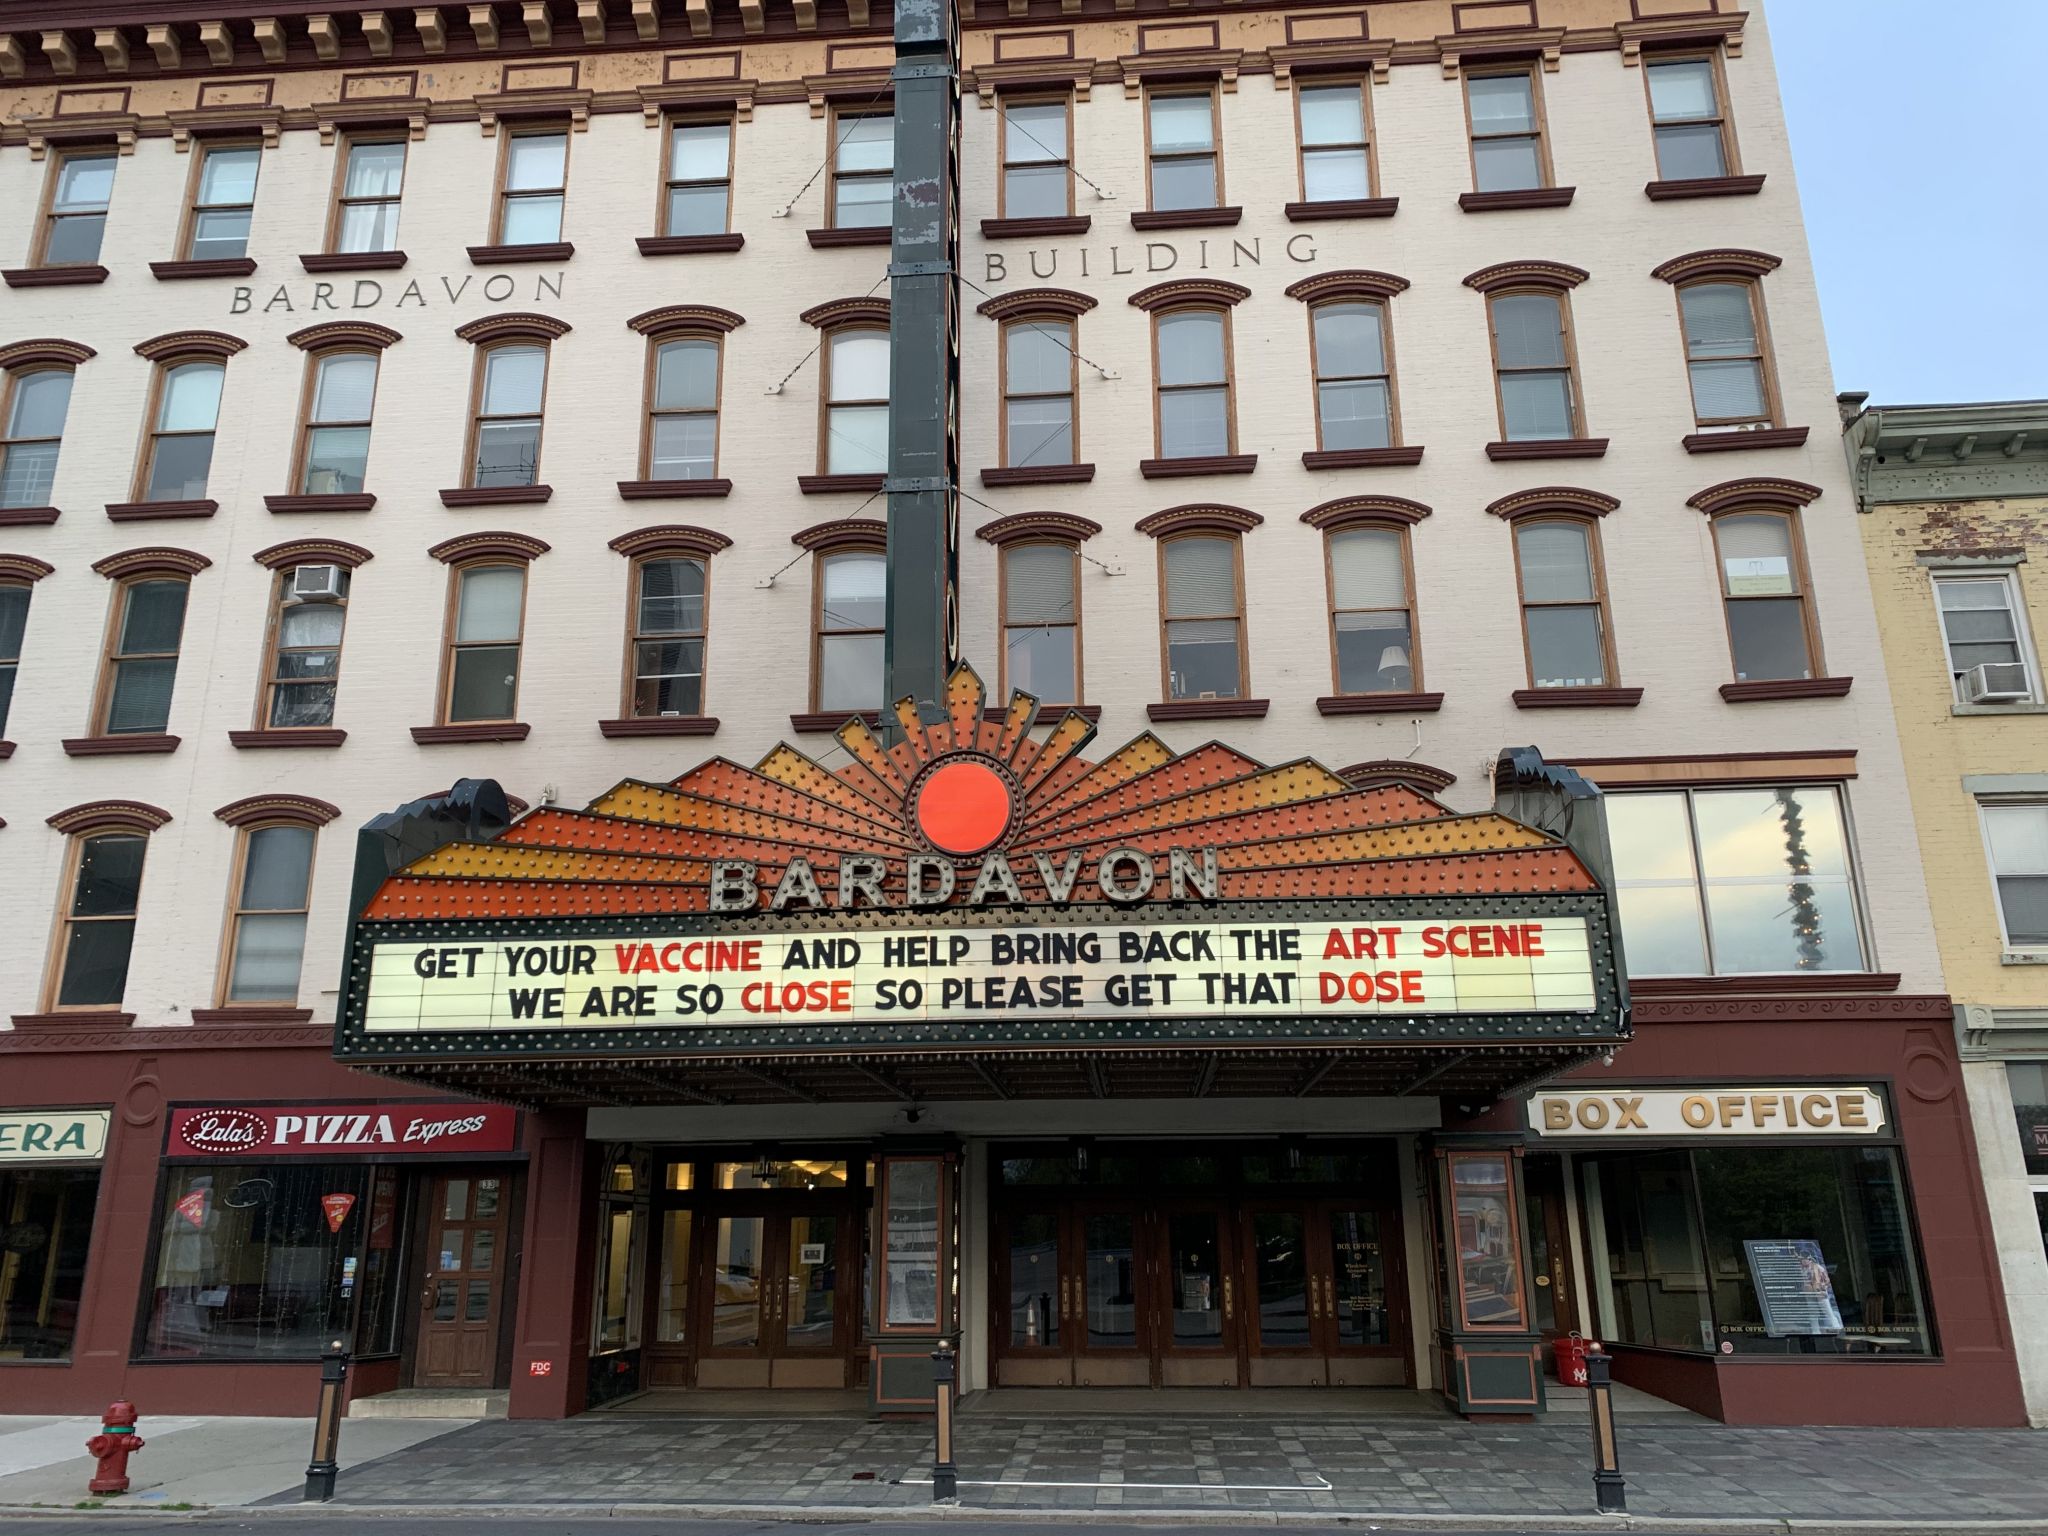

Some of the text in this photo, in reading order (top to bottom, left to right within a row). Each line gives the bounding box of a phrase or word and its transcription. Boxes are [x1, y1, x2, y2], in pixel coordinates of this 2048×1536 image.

[229, 233, 1318, 314] BARDAVON BUILDING
[709, 845, 1219, 913] BARDAVON
[415, 925, 1544, 978] GET YOUR VACCINE AND HELP BRING BACK THE ART SCENE
[509, 970, 1425, 1019] WE ARE SO CLOSE SO PLEASE GET THAT DOSE
[193, 1114, 487, 1145] Lala's PIZZA Express
[1543, 1094, 1868, 1130] BOX OFFICE
[0, 1122, 86, 1152] ERA
[531, 1362, 551, 1371] FDC
